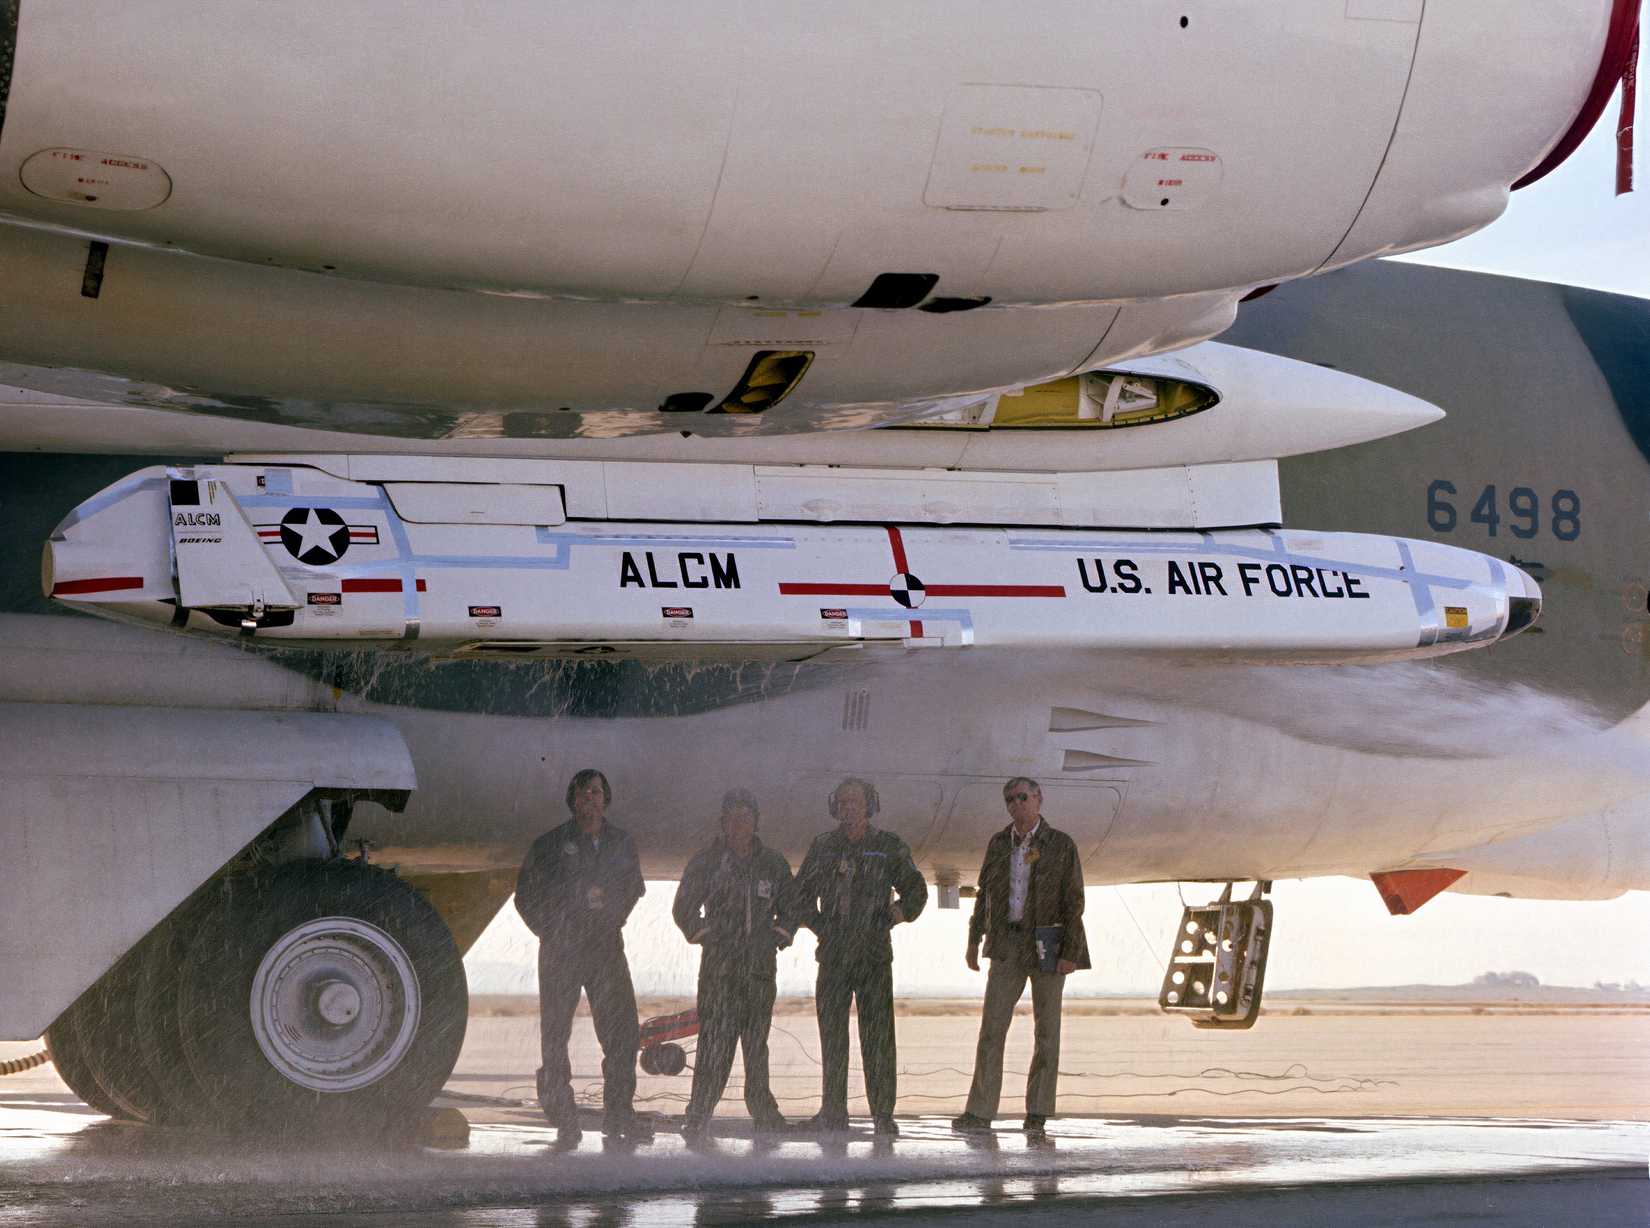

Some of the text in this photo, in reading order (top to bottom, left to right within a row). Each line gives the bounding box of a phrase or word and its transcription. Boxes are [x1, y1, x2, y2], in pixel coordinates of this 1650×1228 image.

[174, 512, 221, 526] ALCM
[1427, 479, 1581, 541] 6498
[620, 552, 741, 589] ALCM
[1076, 558, 1370, 599] U.S. AIR FORCE
